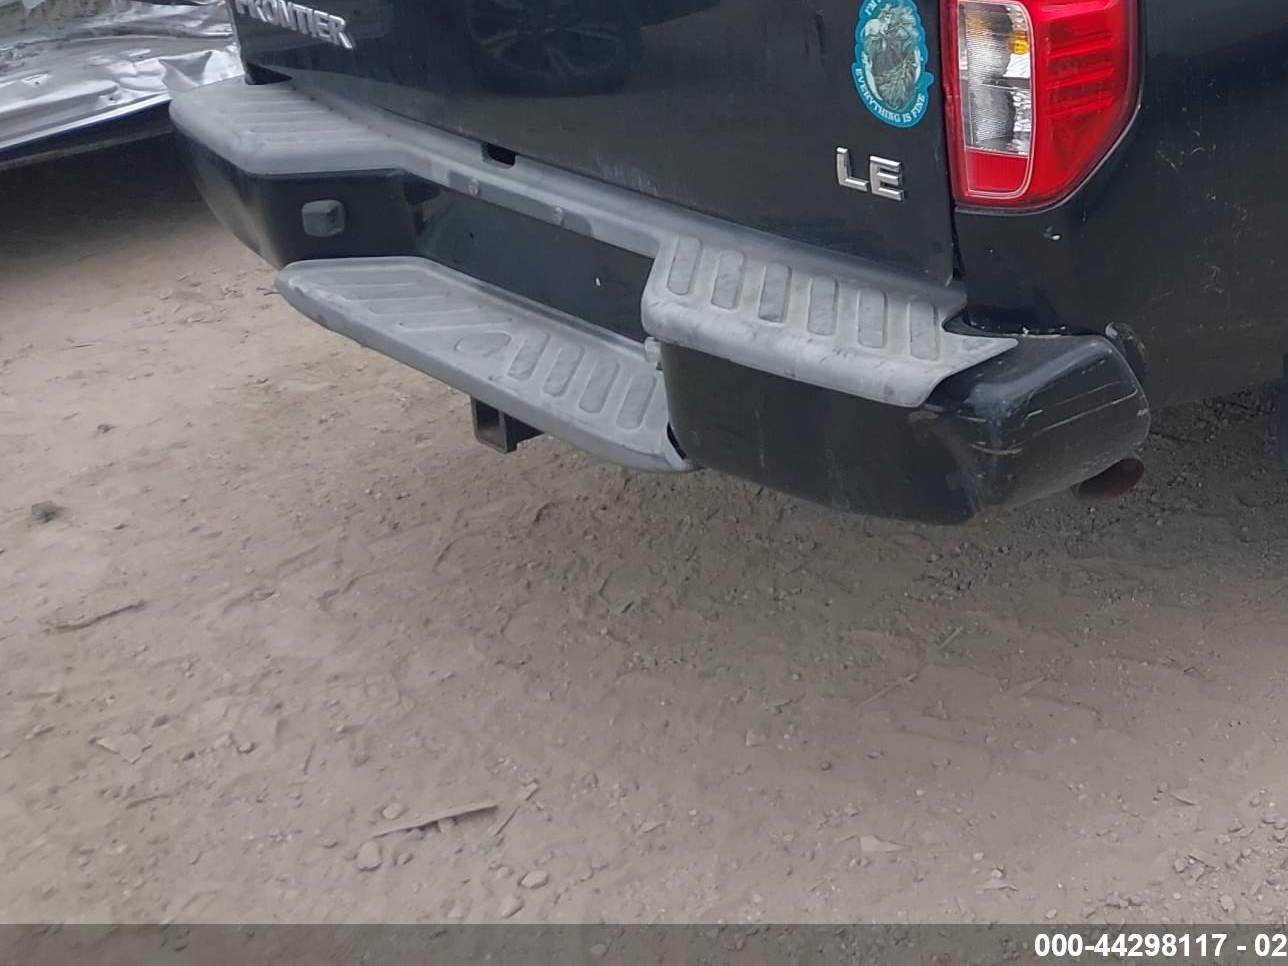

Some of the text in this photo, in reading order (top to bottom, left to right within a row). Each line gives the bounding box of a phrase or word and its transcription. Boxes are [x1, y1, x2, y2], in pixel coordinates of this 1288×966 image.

[855, 68, 926, 123] EVERYTHING IS FINE
[836, 146, 905, 201] LE
